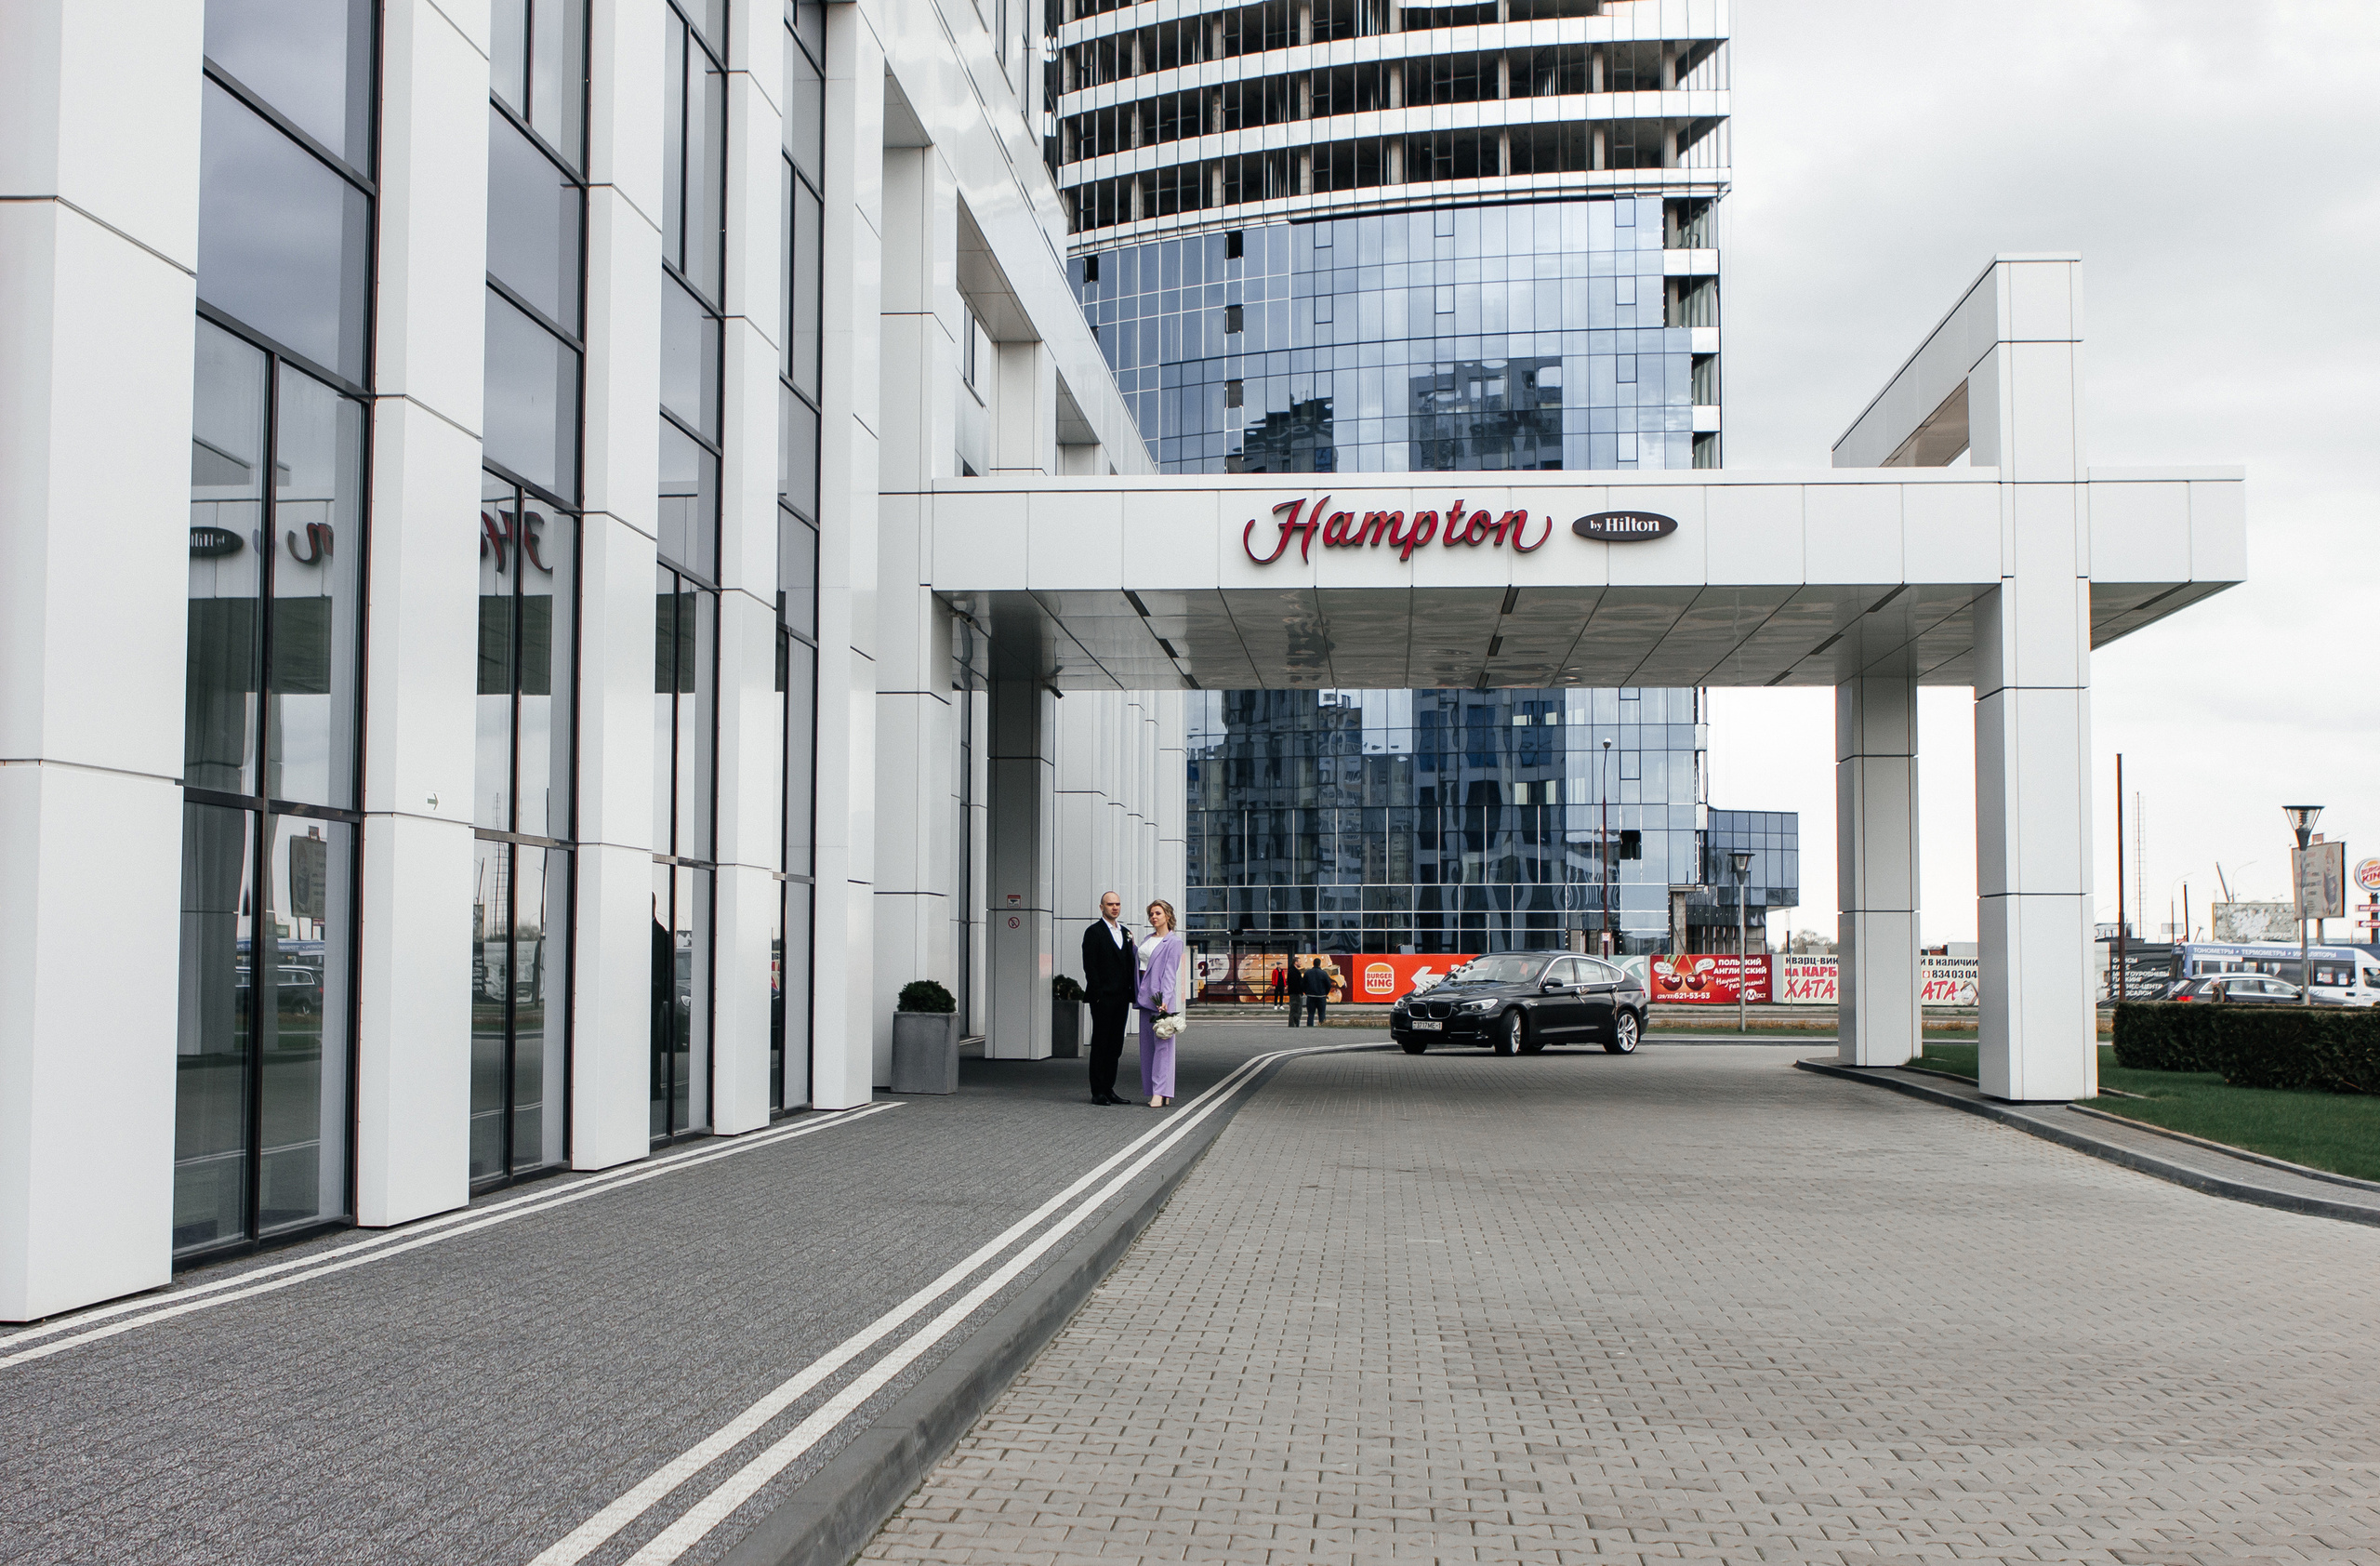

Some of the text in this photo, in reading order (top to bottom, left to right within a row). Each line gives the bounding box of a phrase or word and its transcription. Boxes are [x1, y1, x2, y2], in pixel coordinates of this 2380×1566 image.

[1243, 495, 1553, 564] Hampton
[1590, 516, 1660, 532] by Hilton
[1718, 958, 1762, 966] ПОЛЬКИЙ
[1713, 966, 1767, 975] АНГЛИСКИЙ
[1367, 979, 1393, 988] KING
[1784, 978, 1836, 999] ХАТА
[1921, 980, 1959, 1001] АТА
